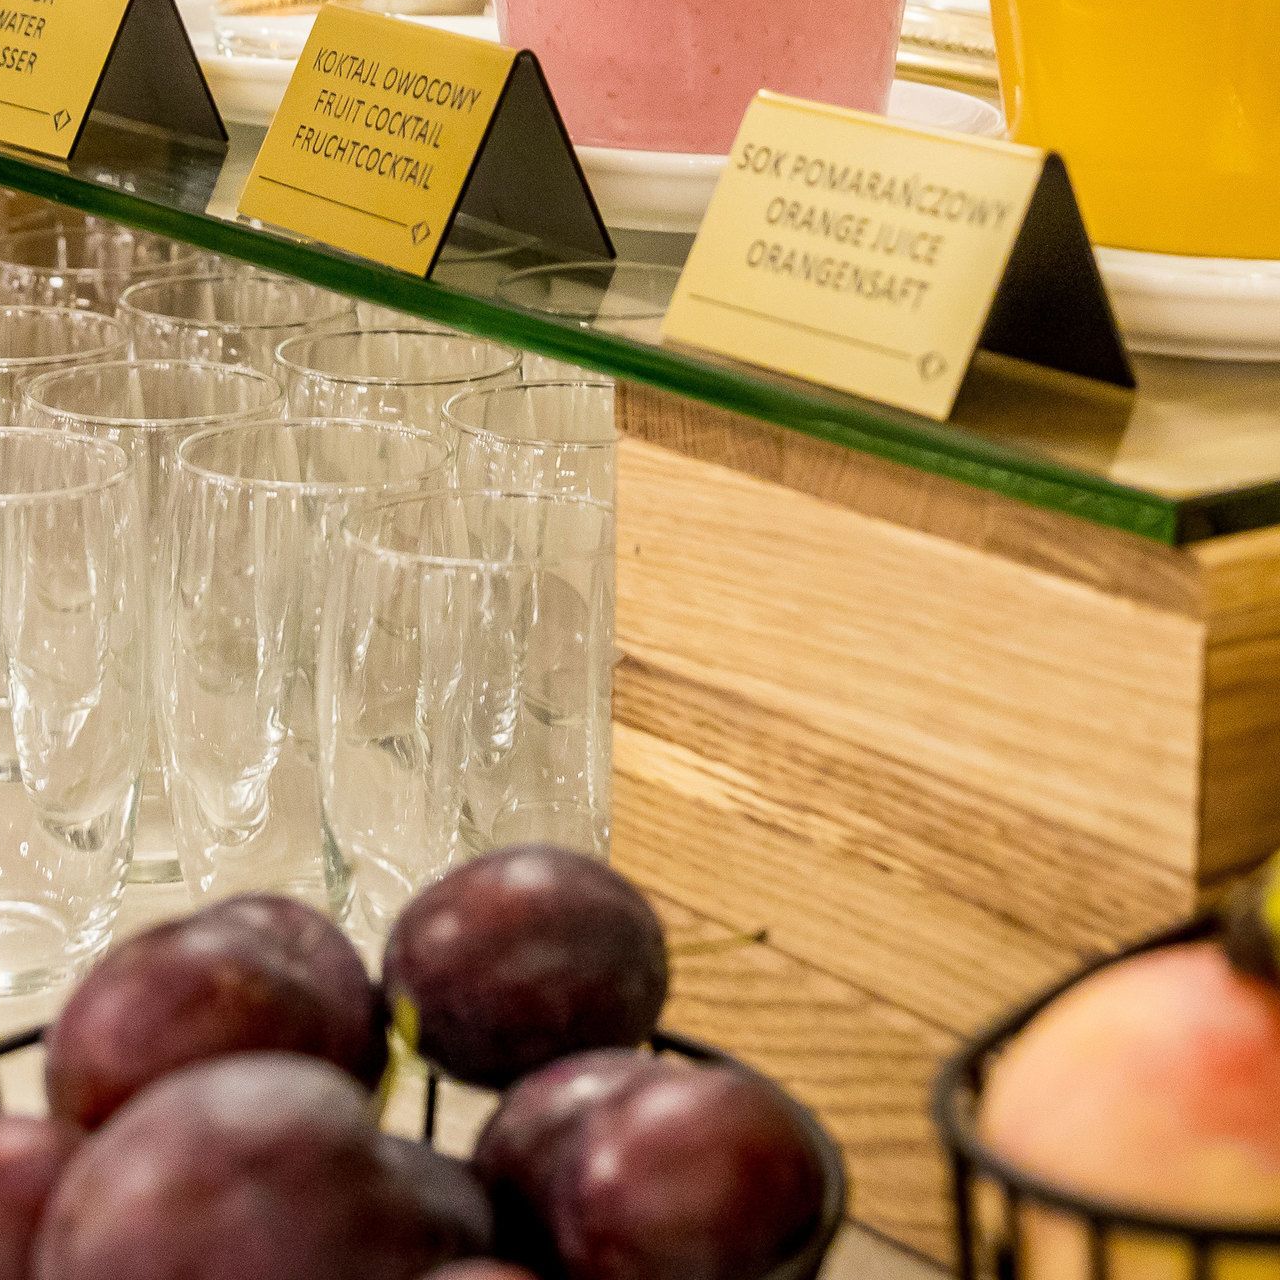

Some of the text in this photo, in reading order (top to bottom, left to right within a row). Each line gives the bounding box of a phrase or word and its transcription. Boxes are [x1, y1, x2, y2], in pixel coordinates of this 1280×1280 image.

[312, 47, 481, 113] KOKTAJL OWOCOWY
[314, 89, 442, 149] FRUIT COCKTAIL
[292, 124, 434, 191] FRUCHTCOCKTAIL
[736, 143, 1014, 231] SOK POMARAŃCZOWY
[766, 197, 945, 266] ORANGE JUICE
[747, 239, 931, 311] ORANGENSAFT
